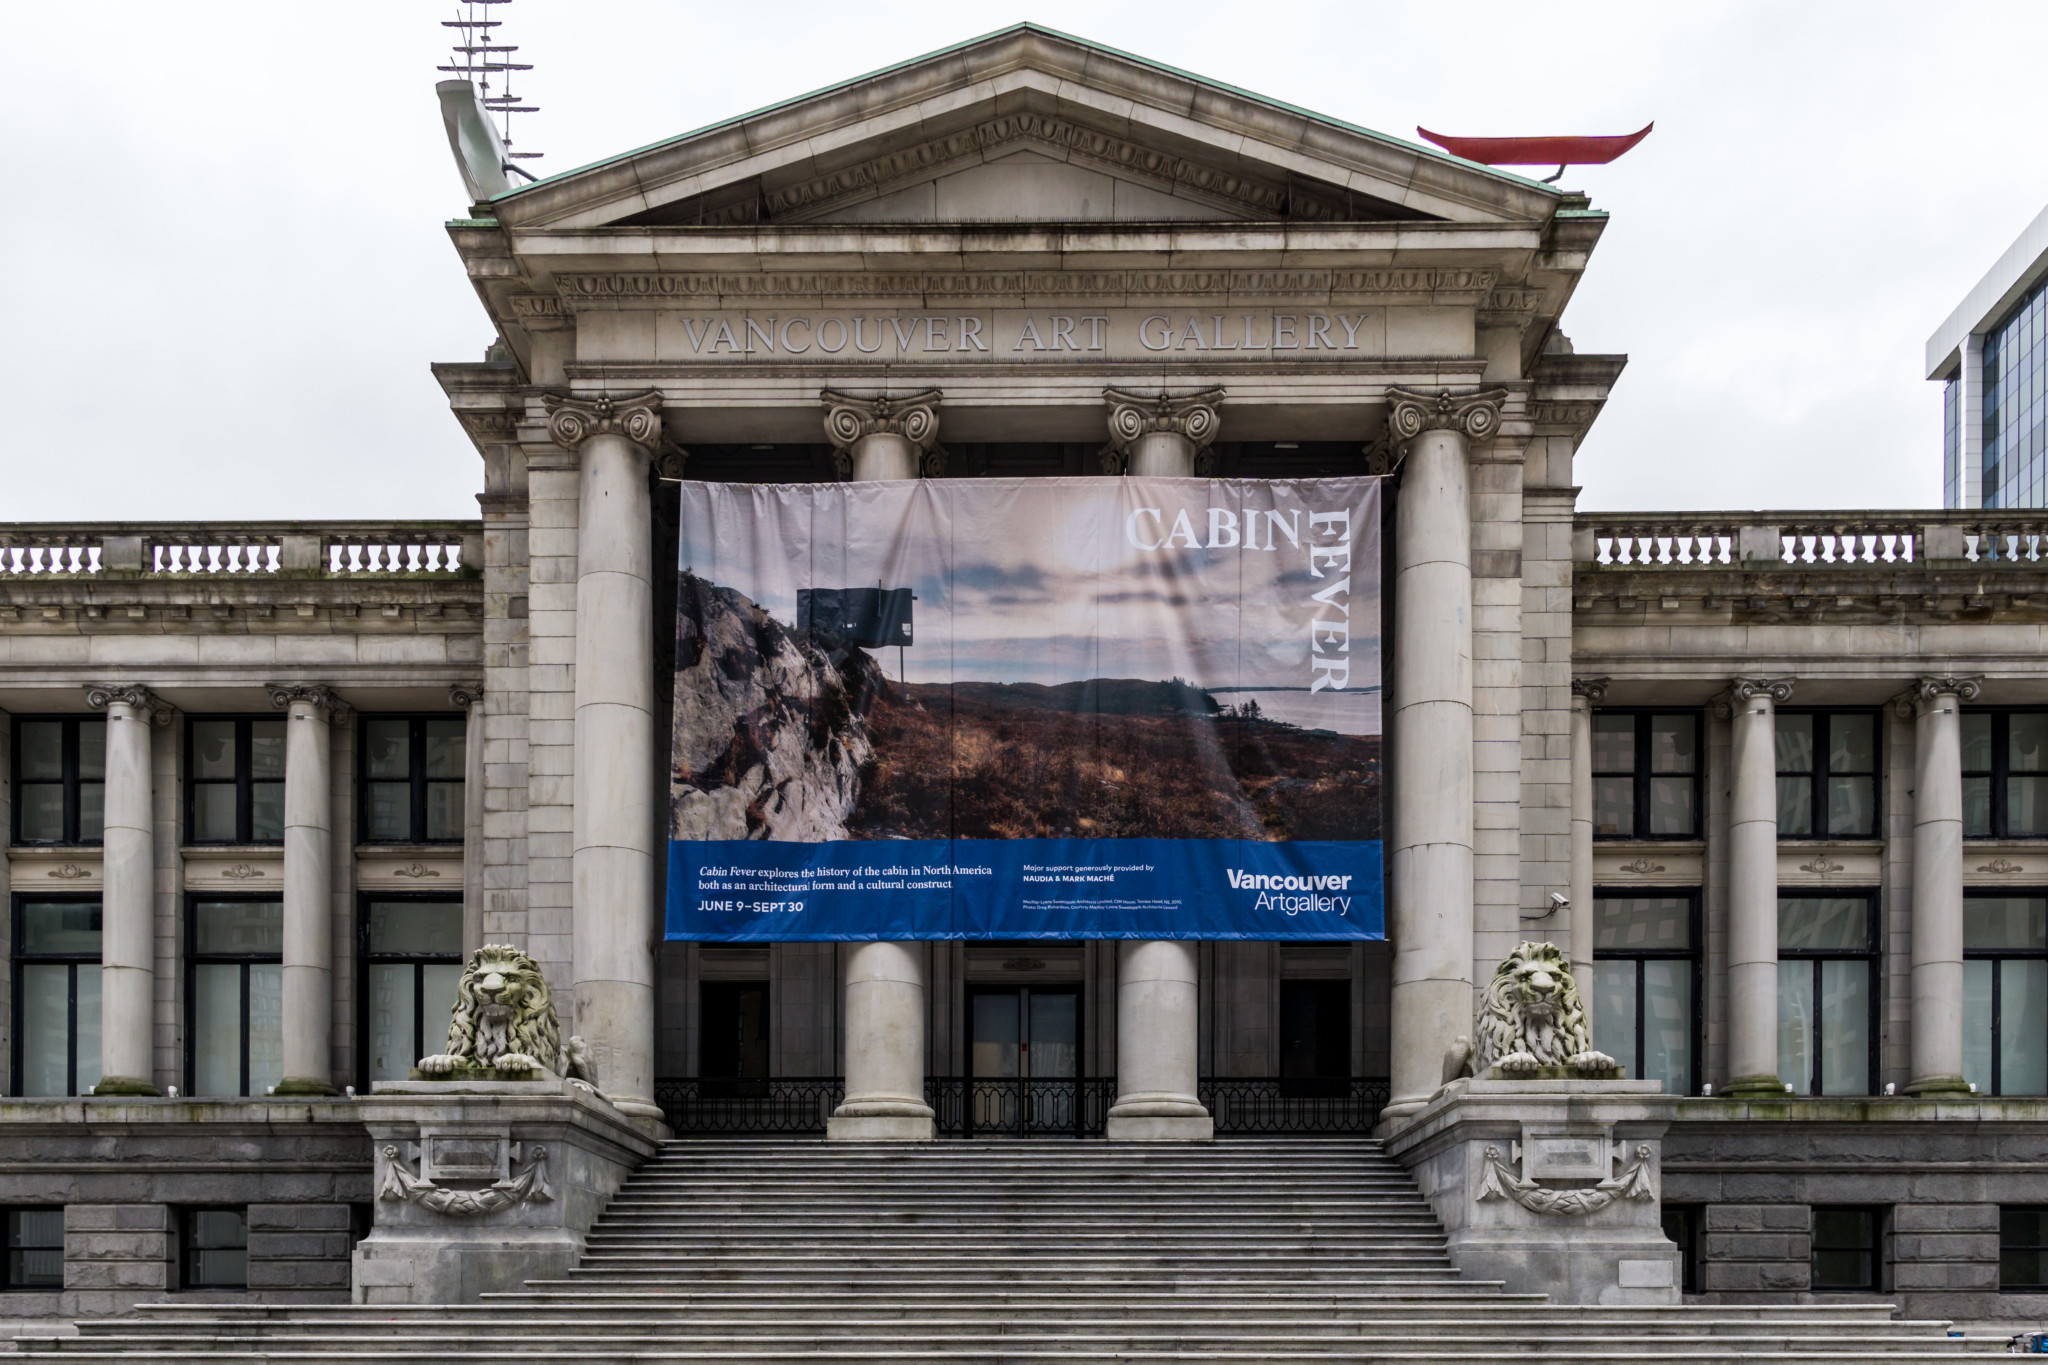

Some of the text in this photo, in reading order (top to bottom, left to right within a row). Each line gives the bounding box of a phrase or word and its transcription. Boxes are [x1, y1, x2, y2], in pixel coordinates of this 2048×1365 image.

[681, 314, 1368, 354] VANCOUVER ART GALLERY
[1126, 507, 1301, 551] CABIN
[1309, 507, 1350, 695] FEVER
[699, 865, 993, 879] Cabin Fever explores the history of the cabin in North America
[1023, 864, 1154, 873] Major support generously provided by
[698, 880, 720, 890] both
[721, 881, 732, 890] as
[734, 881, 747, 890] an
[748, 881, 811, 892] architectural
[812, 881, 835, 891] form
[837, 880, 856, 890] and
[858, 881, 864, 890] a
[866, 879, 905, 890] cultural
[1023, 875, 1054, 883] NAUDIA
[1086, 874, 1115, 882] MACHÉ
[1226, 868, 1352, 891] Vancouver
[697, 900, 733, 912] JUNE
[787, 901, 804, 912] 30
[1254, 891, 1351, 916] Artgallery
